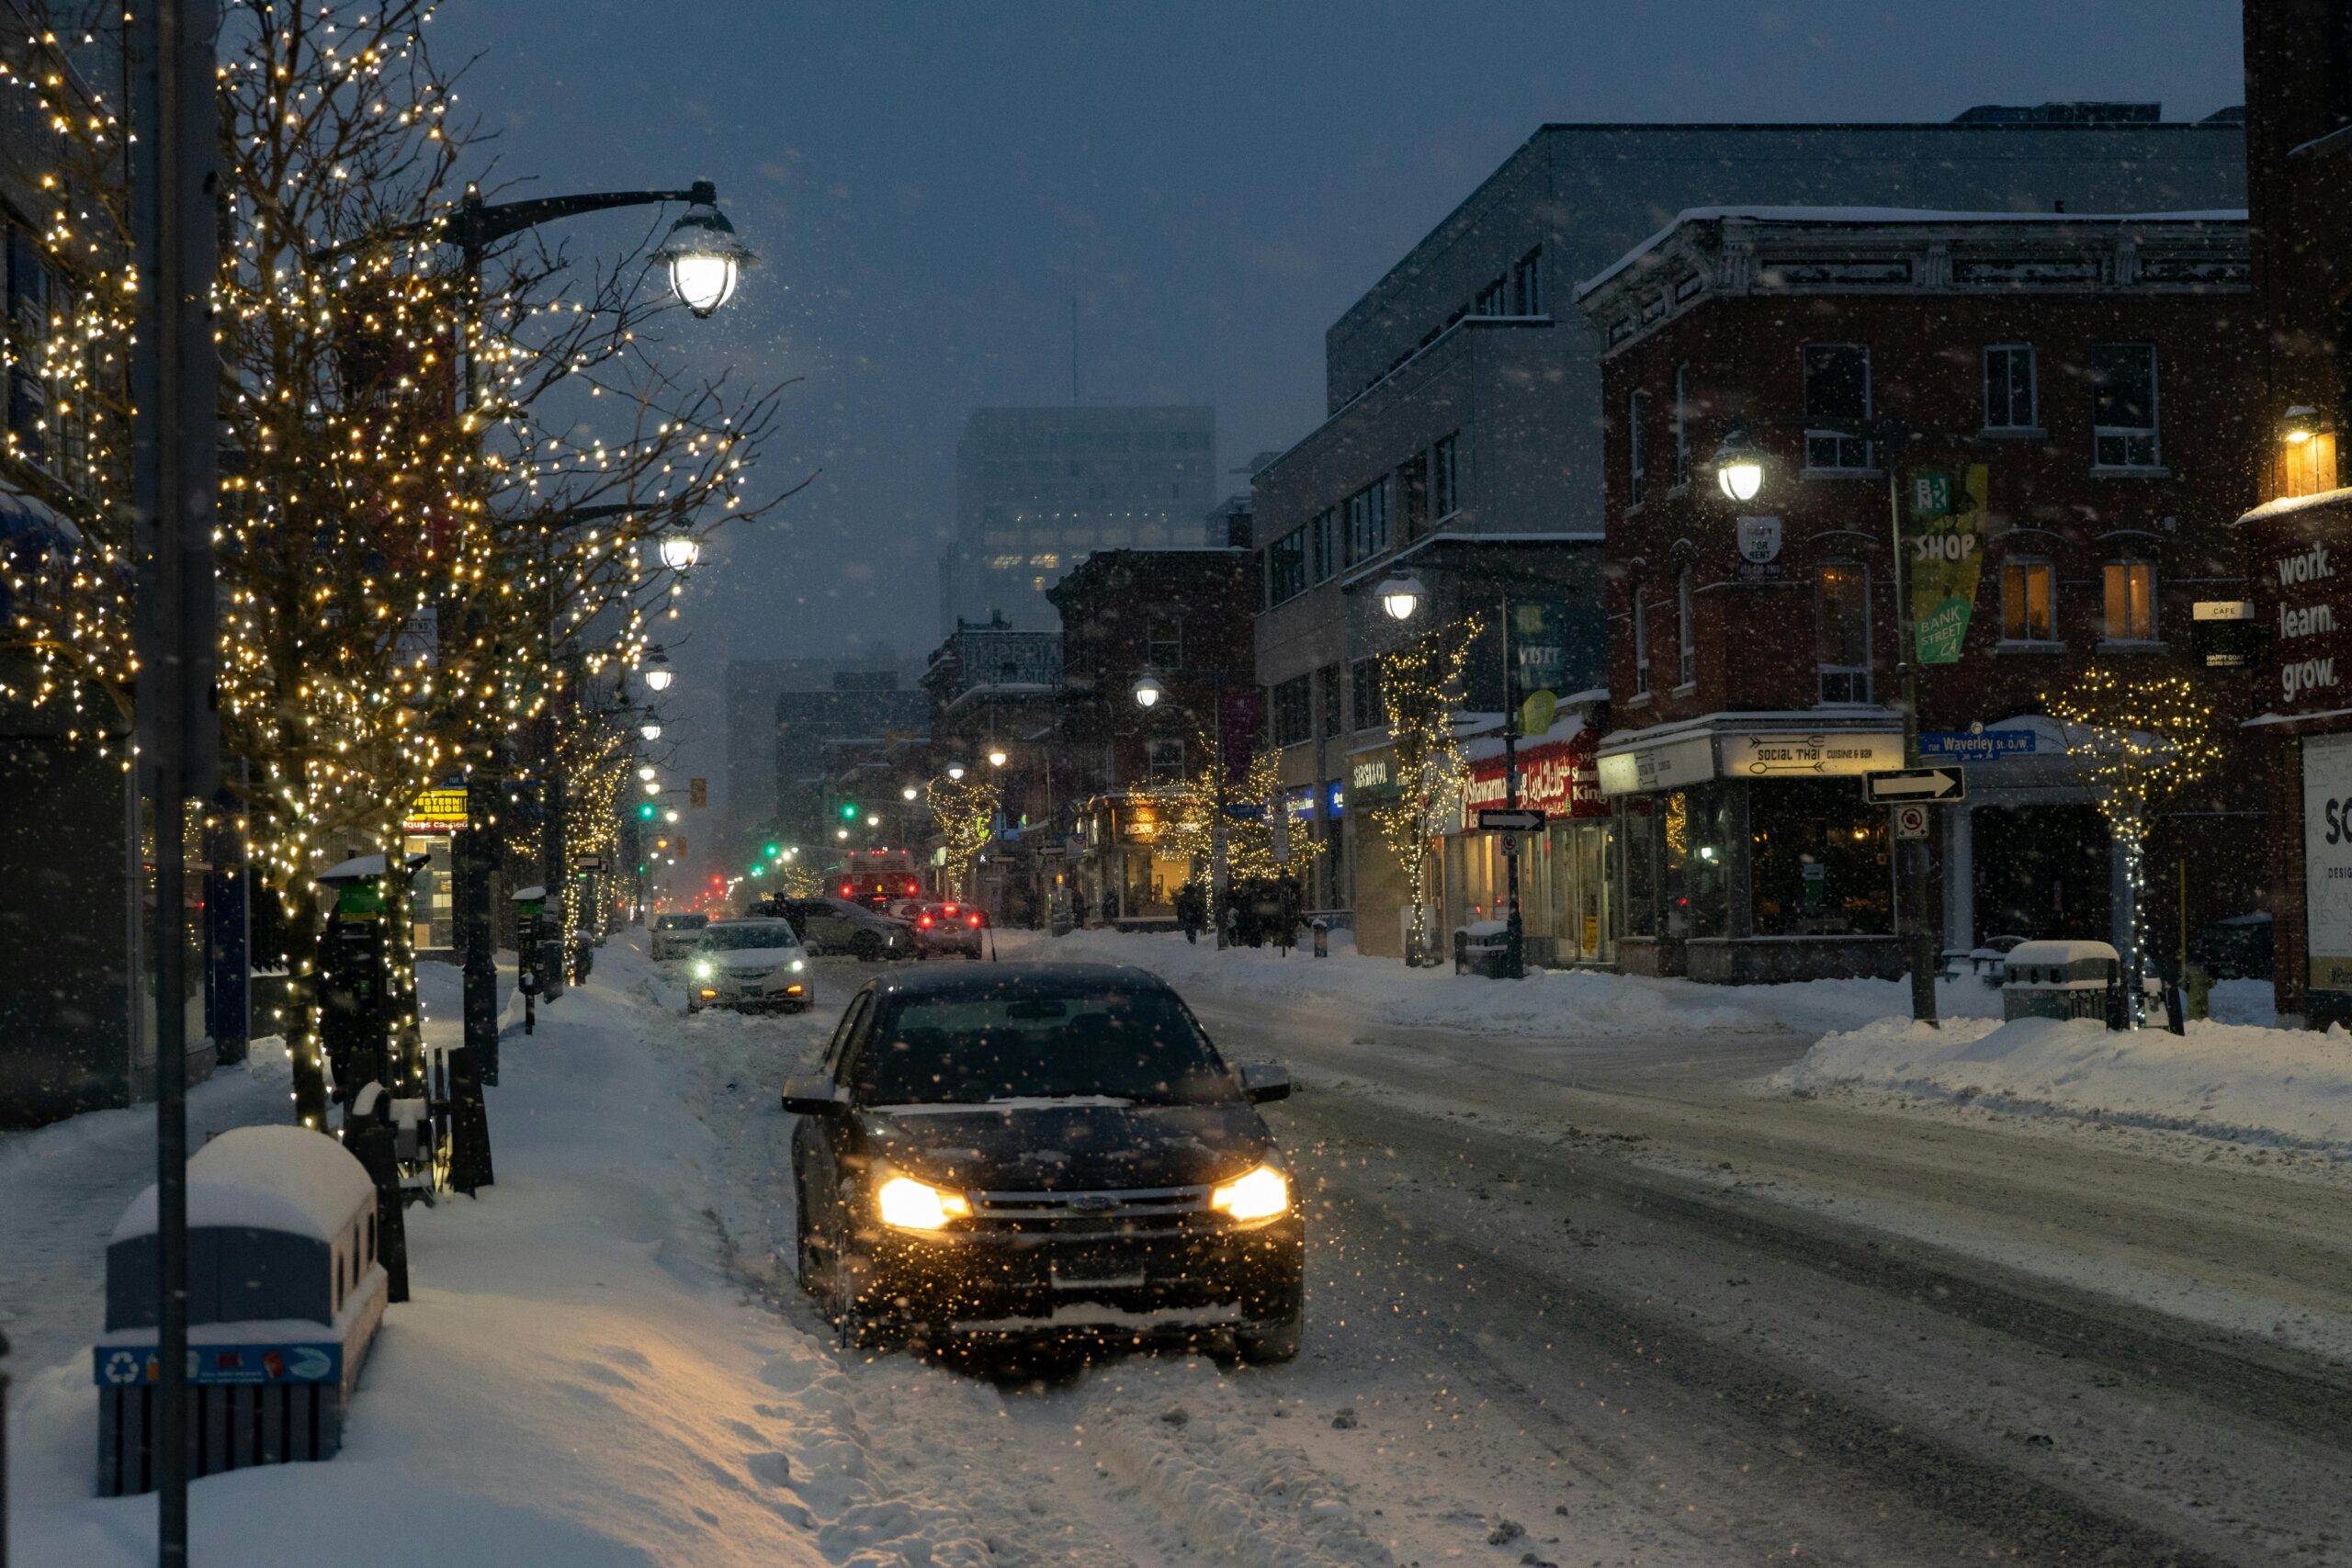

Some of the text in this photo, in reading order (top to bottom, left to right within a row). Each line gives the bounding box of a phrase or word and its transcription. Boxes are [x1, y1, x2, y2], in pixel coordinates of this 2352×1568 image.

[1749, 550, 1770, 559] RENT
[1917, 534, 1975, 561] SHOP
[2278, 540, 2335, 586] work.
[1921, 604, 1961, 633] BANK
[2280, 602, 2338, 639] learn.
[1921, 622, 1962, 646] STREET
[1519, 646, 1561, 664] VISIT
[2282, 657, 2339, 703] grow.
[1758, 749, 1793, 761] SOCIAL
[1796, 749, 1820, 761] THAI
[1826, 750, 1853, 759] CUISINE
[1860, 749, 1872, 759] BAR
[1943, 736, 1994, 752] Waverley
[1468, 773, 1508, 806] Shawarma
